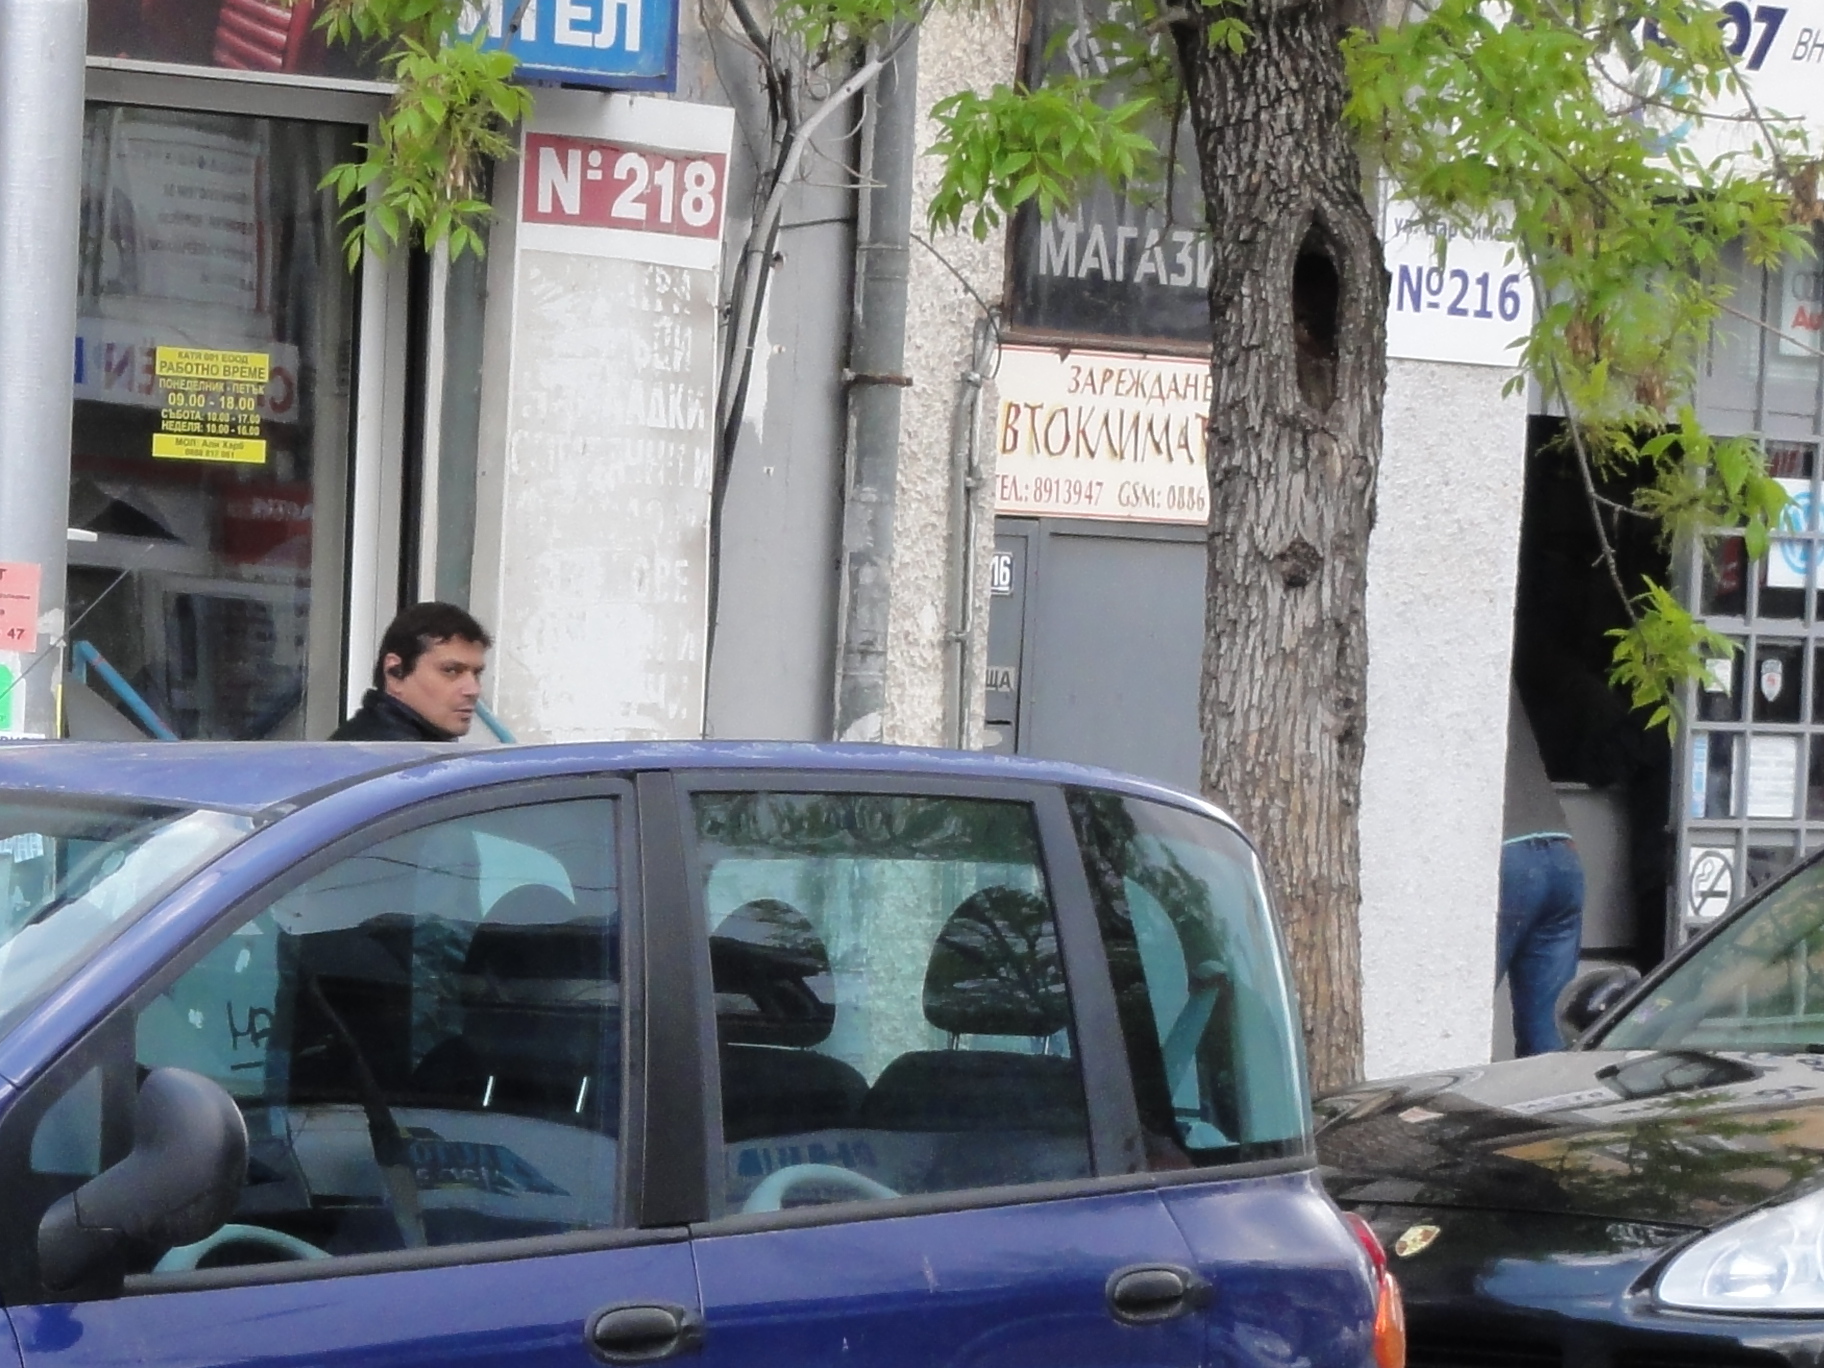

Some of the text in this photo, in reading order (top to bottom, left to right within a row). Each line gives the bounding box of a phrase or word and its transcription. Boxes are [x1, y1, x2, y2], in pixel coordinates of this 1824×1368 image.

[159, 360, 266, 380] РАБОТНО ВРЕМЕ
[159, 378, 224, 393] ПОНЕДЕЛНИК
[1067, 365, 1213, 407] ЗАРЕЖДАНЕ
[167, 392, 206, 408] 09.00
[220, 396, 256, 411] 18.00
[1033, 476, 1104, 507] 8913947
[7, 627, 26, 640] 47
